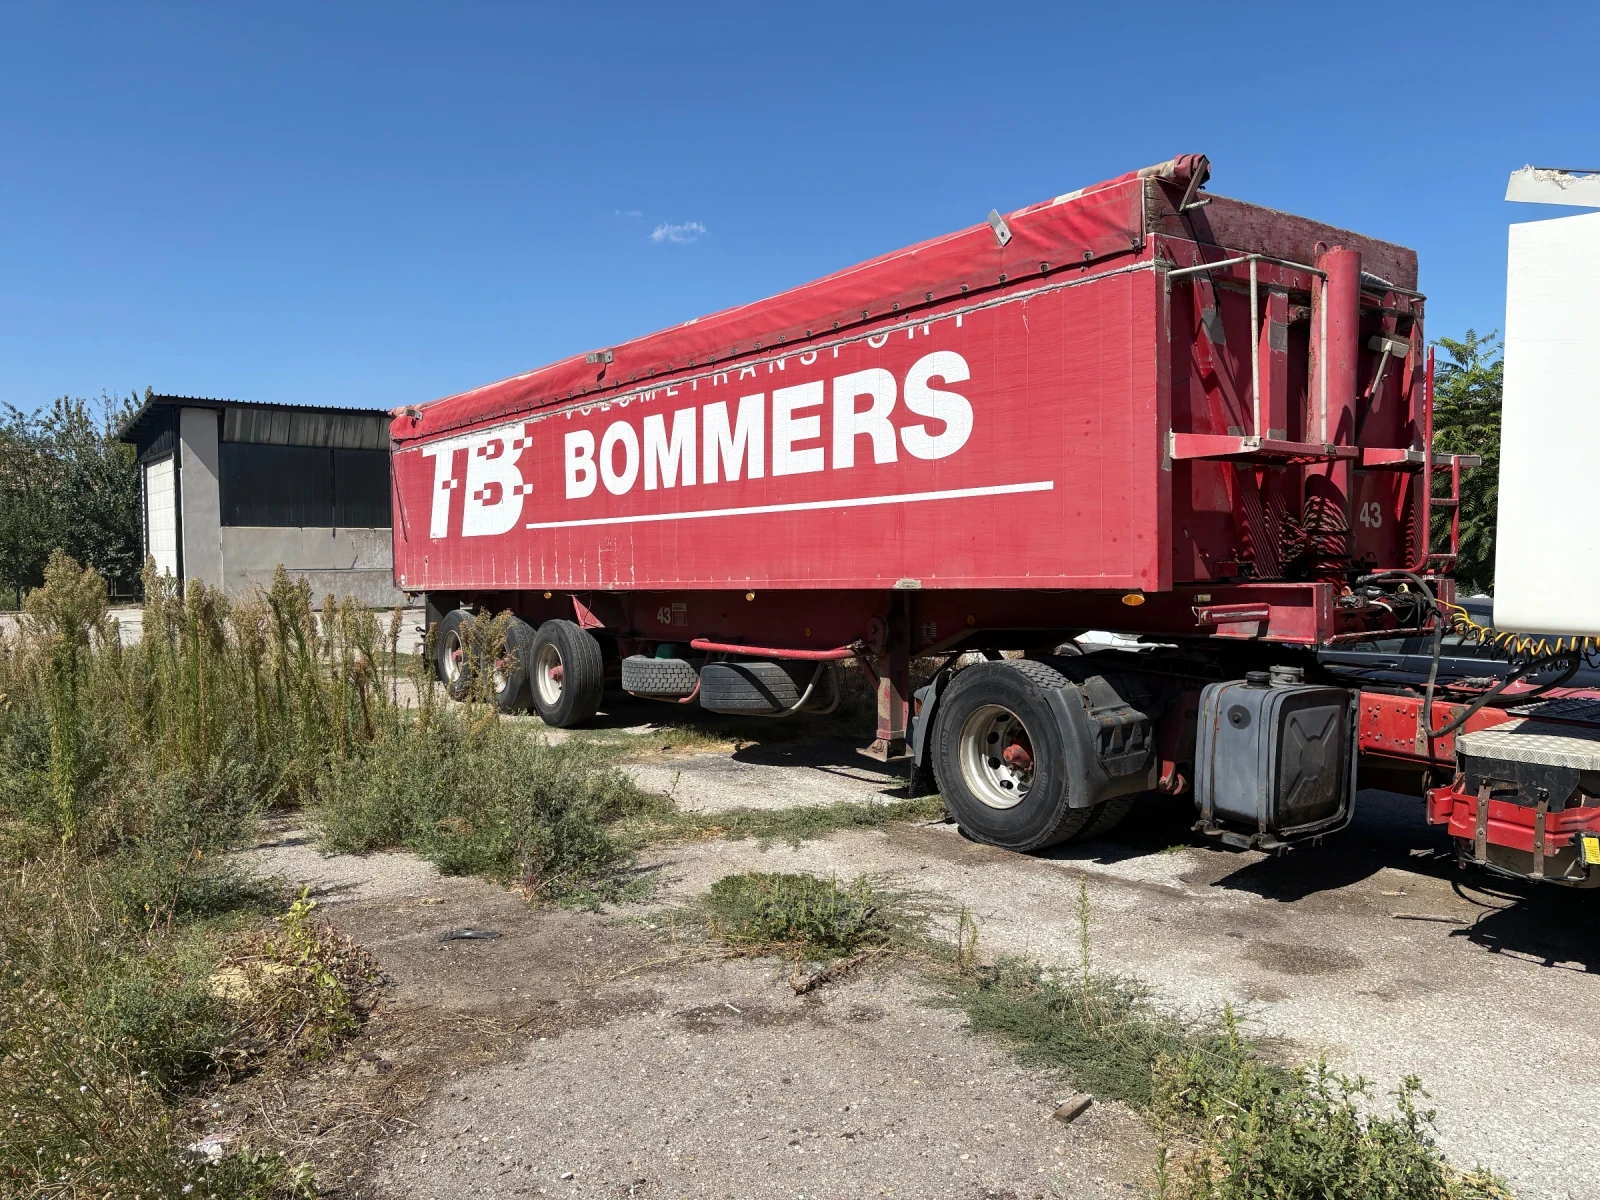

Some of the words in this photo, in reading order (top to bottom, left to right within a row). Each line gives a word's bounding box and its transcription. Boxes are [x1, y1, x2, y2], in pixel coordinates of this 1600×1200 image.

[564, 350, 974, 500] BOMMERS
[422, 422, 533, 538] TB
[1359, 501, 1382, 529] 43
[656, 606, 672, 625] 43
